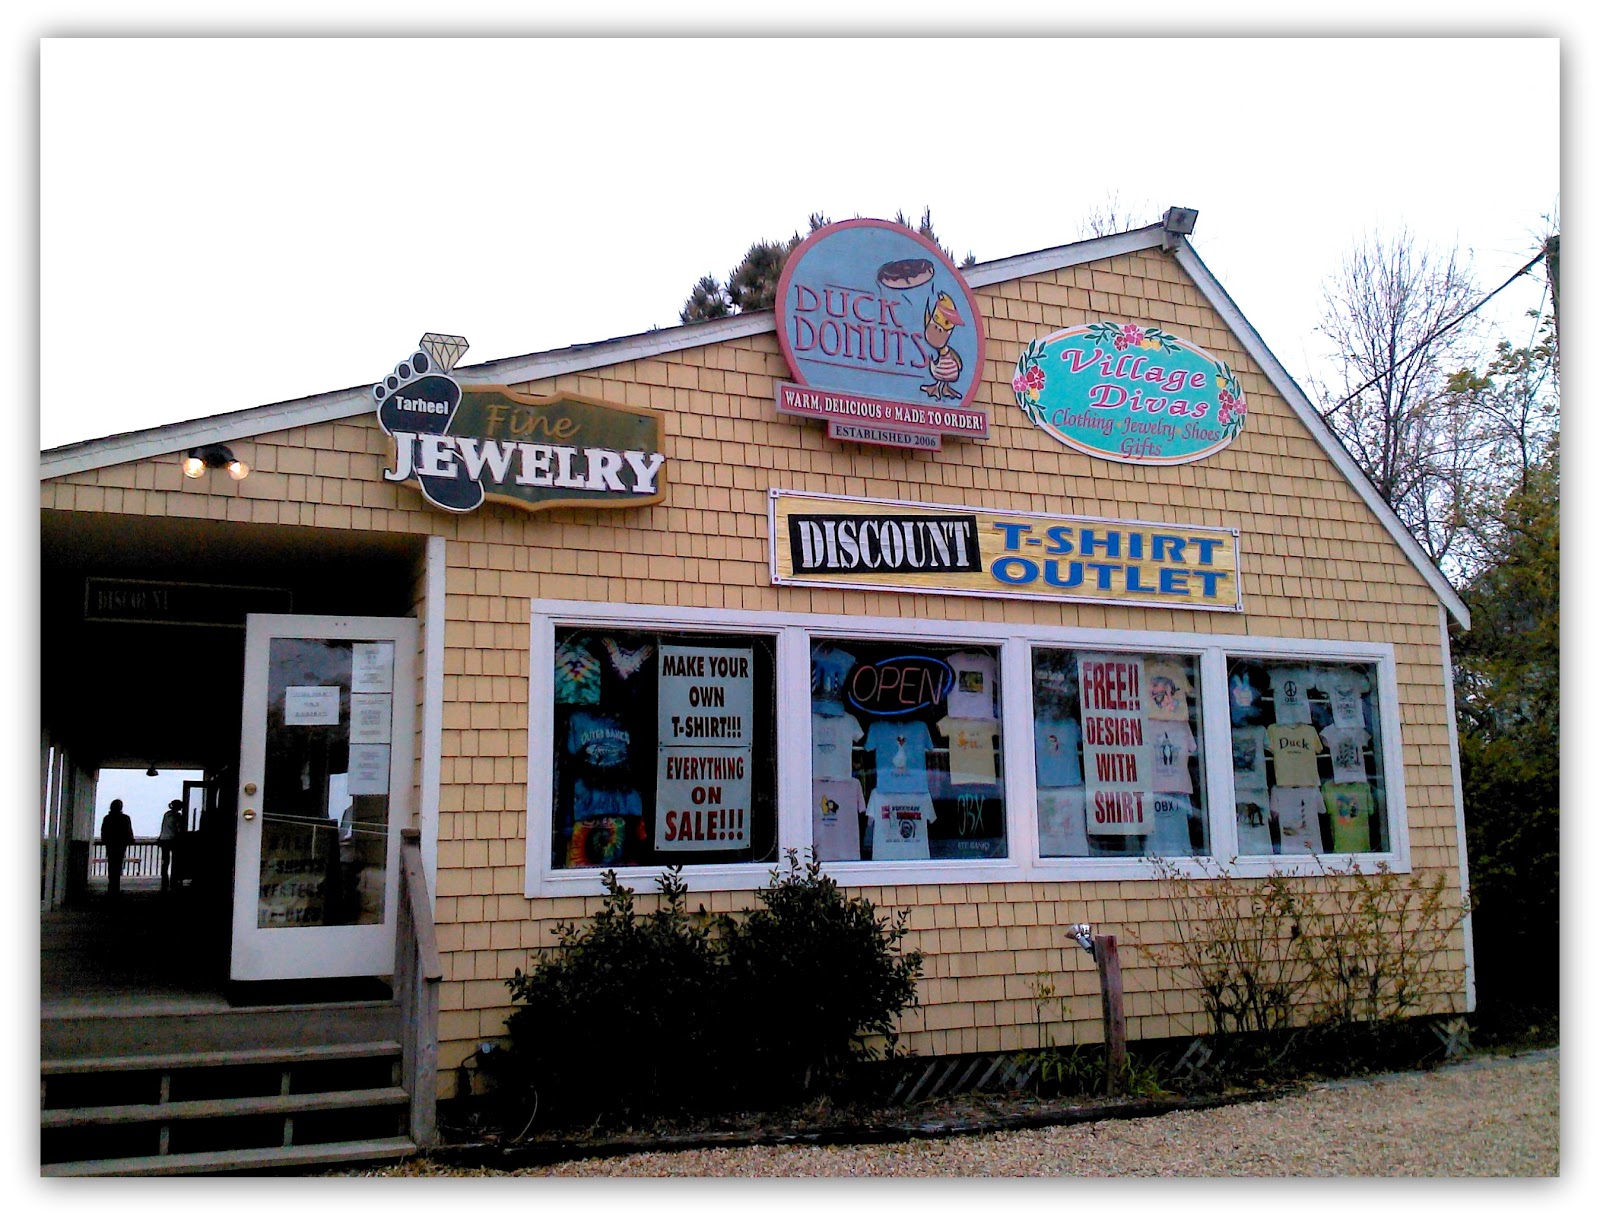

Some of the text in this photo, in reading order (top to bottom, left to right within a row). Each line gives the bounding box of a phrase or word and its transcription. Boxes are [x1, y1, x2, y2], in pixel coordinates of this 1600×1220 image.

[794, 284, 902, 328] DUCK
[793, 315, 929, 369] DONUTS
[1061, 348, 1207, 391] Village
[395, 395, 449, 415] Tarheel
[785, 390, 984, 430] WARM, DELICIOUS & MADE TO ORDER!
[1089, 384, 1209, 418] Divas
[486, 404, 582, 439] Fine
[835, 425, 937, 447] ESTABLISHED 2006
[1051, 408, 1221, 442] Clothing Jewelry Shoes
[384, 430, 665, 494] JEWELRY
[1120, 437, 1162, 460] Gifts
[797, 519, 1226, 568] DISCOUNT T-SHIRT
[990, 555, 1228, 598] OUTLET
[662, 655, 749, 679] MAKE YOUR
[688, 685, 726, 708] OWN
[853, 664, 945, 706] OPEN
[1082, 661, 1141, 711] FREE!!
[671, 715, 742, 739] T-SHIRT!!!
[1085, 716, 1144, 747] DESIGN
[1279, 736, 1310, 751] Duck
[666, 756, 744, 780] EVERYTHING
[1095, 752, 1138, 783] WITH
[691, 786, 722, 805] ON
[1094, 790, 1145, 824] SHIRT
[1154, 800, 1174, 813] OBX
[664, 808, 744, 842] SALE!!!
